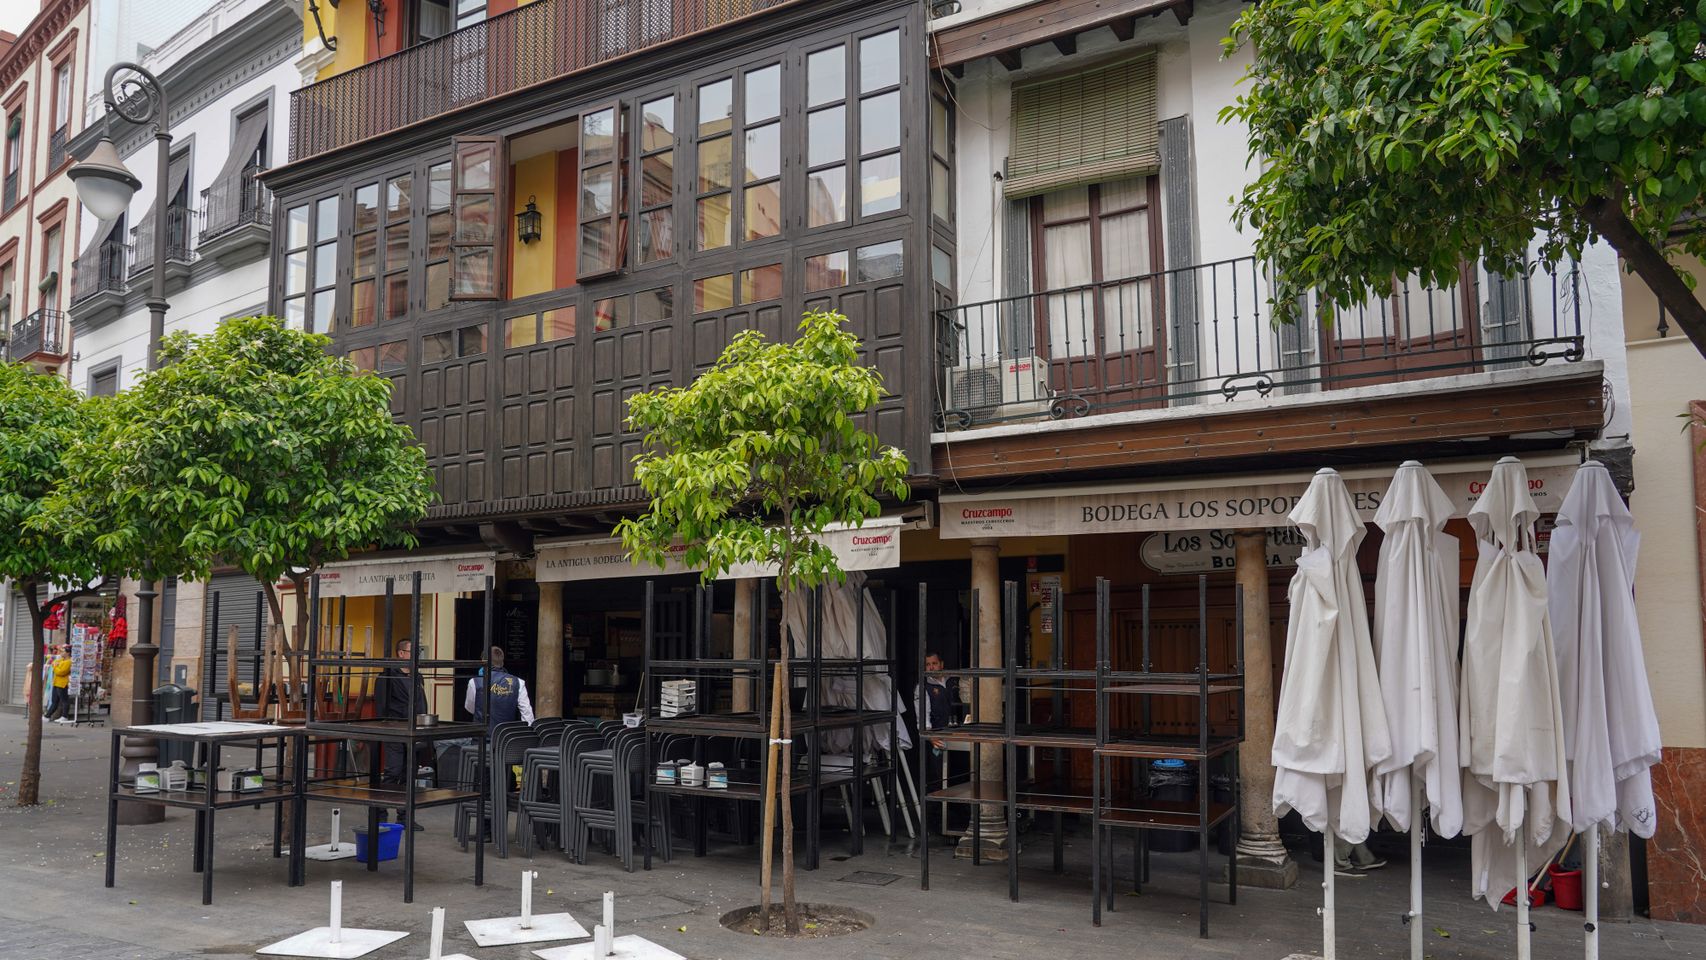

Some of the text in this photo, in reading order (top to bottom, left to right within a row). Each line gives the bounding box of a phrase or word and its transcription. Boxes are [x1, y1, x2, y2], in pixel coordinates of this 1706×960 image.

[962, 507, 1013, 519] Cruzcampo
[1081, 503, 1169, 522] BODEGA
[1177, 500, 1219, 519] LOS
[852, 535, 893, 546] Cruzcampo
[1163, 532, 1201, 553] Los
[546, 560, 556, 569] LA
[558, 557, 591, 568] ANTIGUA
[359, 575, 368, 584] LA
